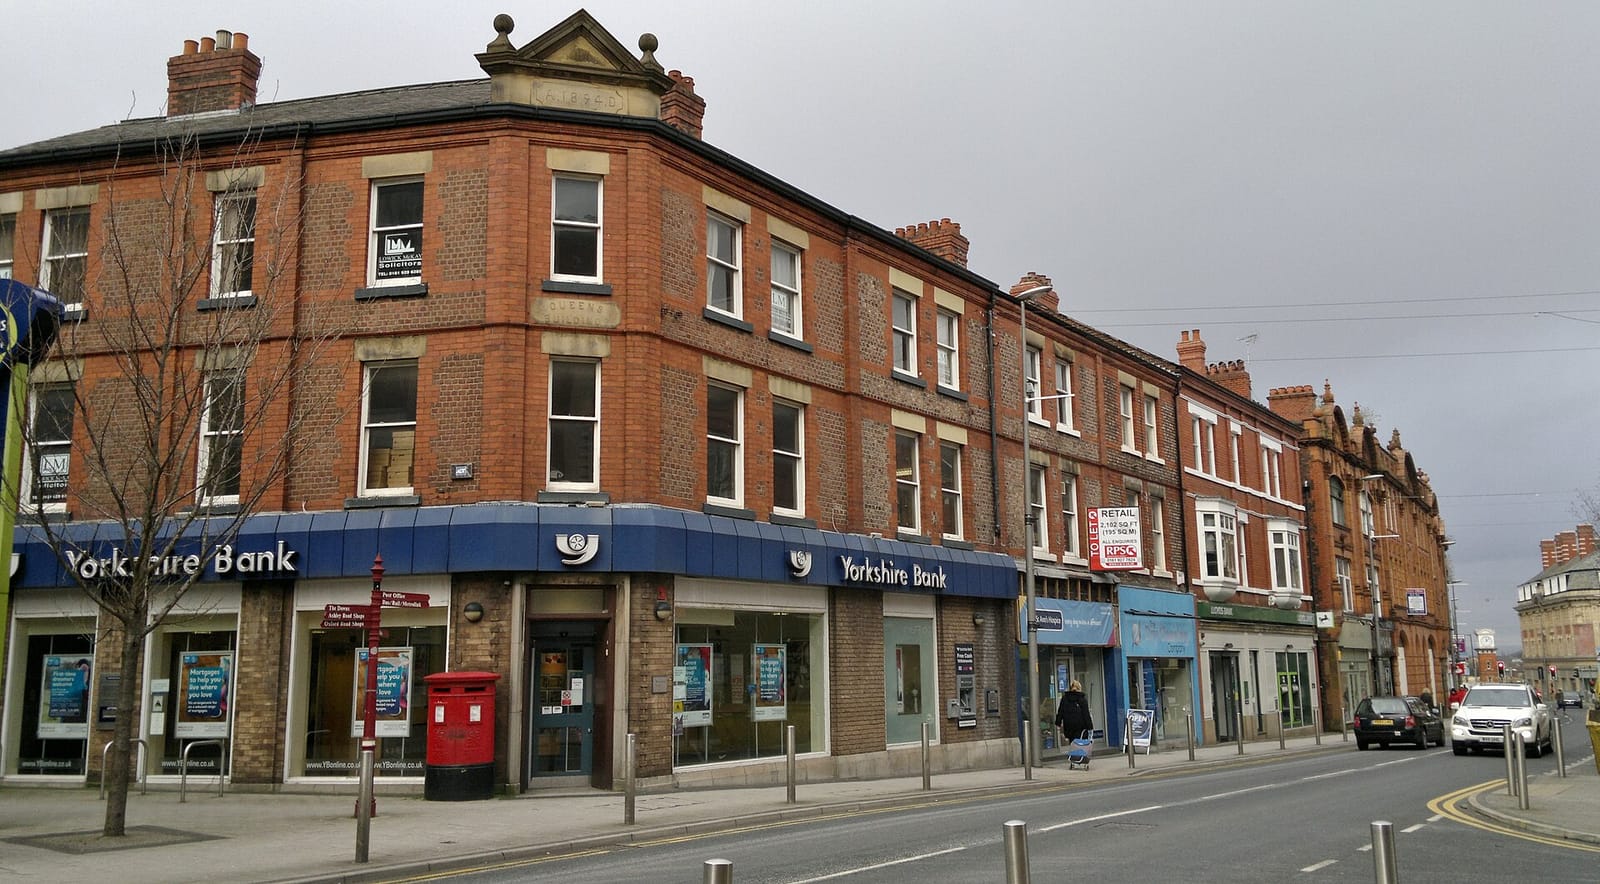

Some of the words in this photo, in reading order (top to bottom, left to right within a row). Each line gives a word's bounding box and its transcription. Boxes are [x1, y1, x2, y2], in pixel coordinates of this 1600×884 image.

[379, 261, 422, 269] Solicitors
[550, 301, 604, 314] QUEENS
[1101, 509, 1136, 518] RETAIL
[1089, 521, 1099, 541] LET
[214, 540, 297, 573] Bank
[1090, 543, 1100, 557] TO
[840, 555, 909, 586] Yorkshire
[913, 563, 947, 589] Bank
[190, 668, 220, 677] Mortgages
[198, 676, 209, 684] help
